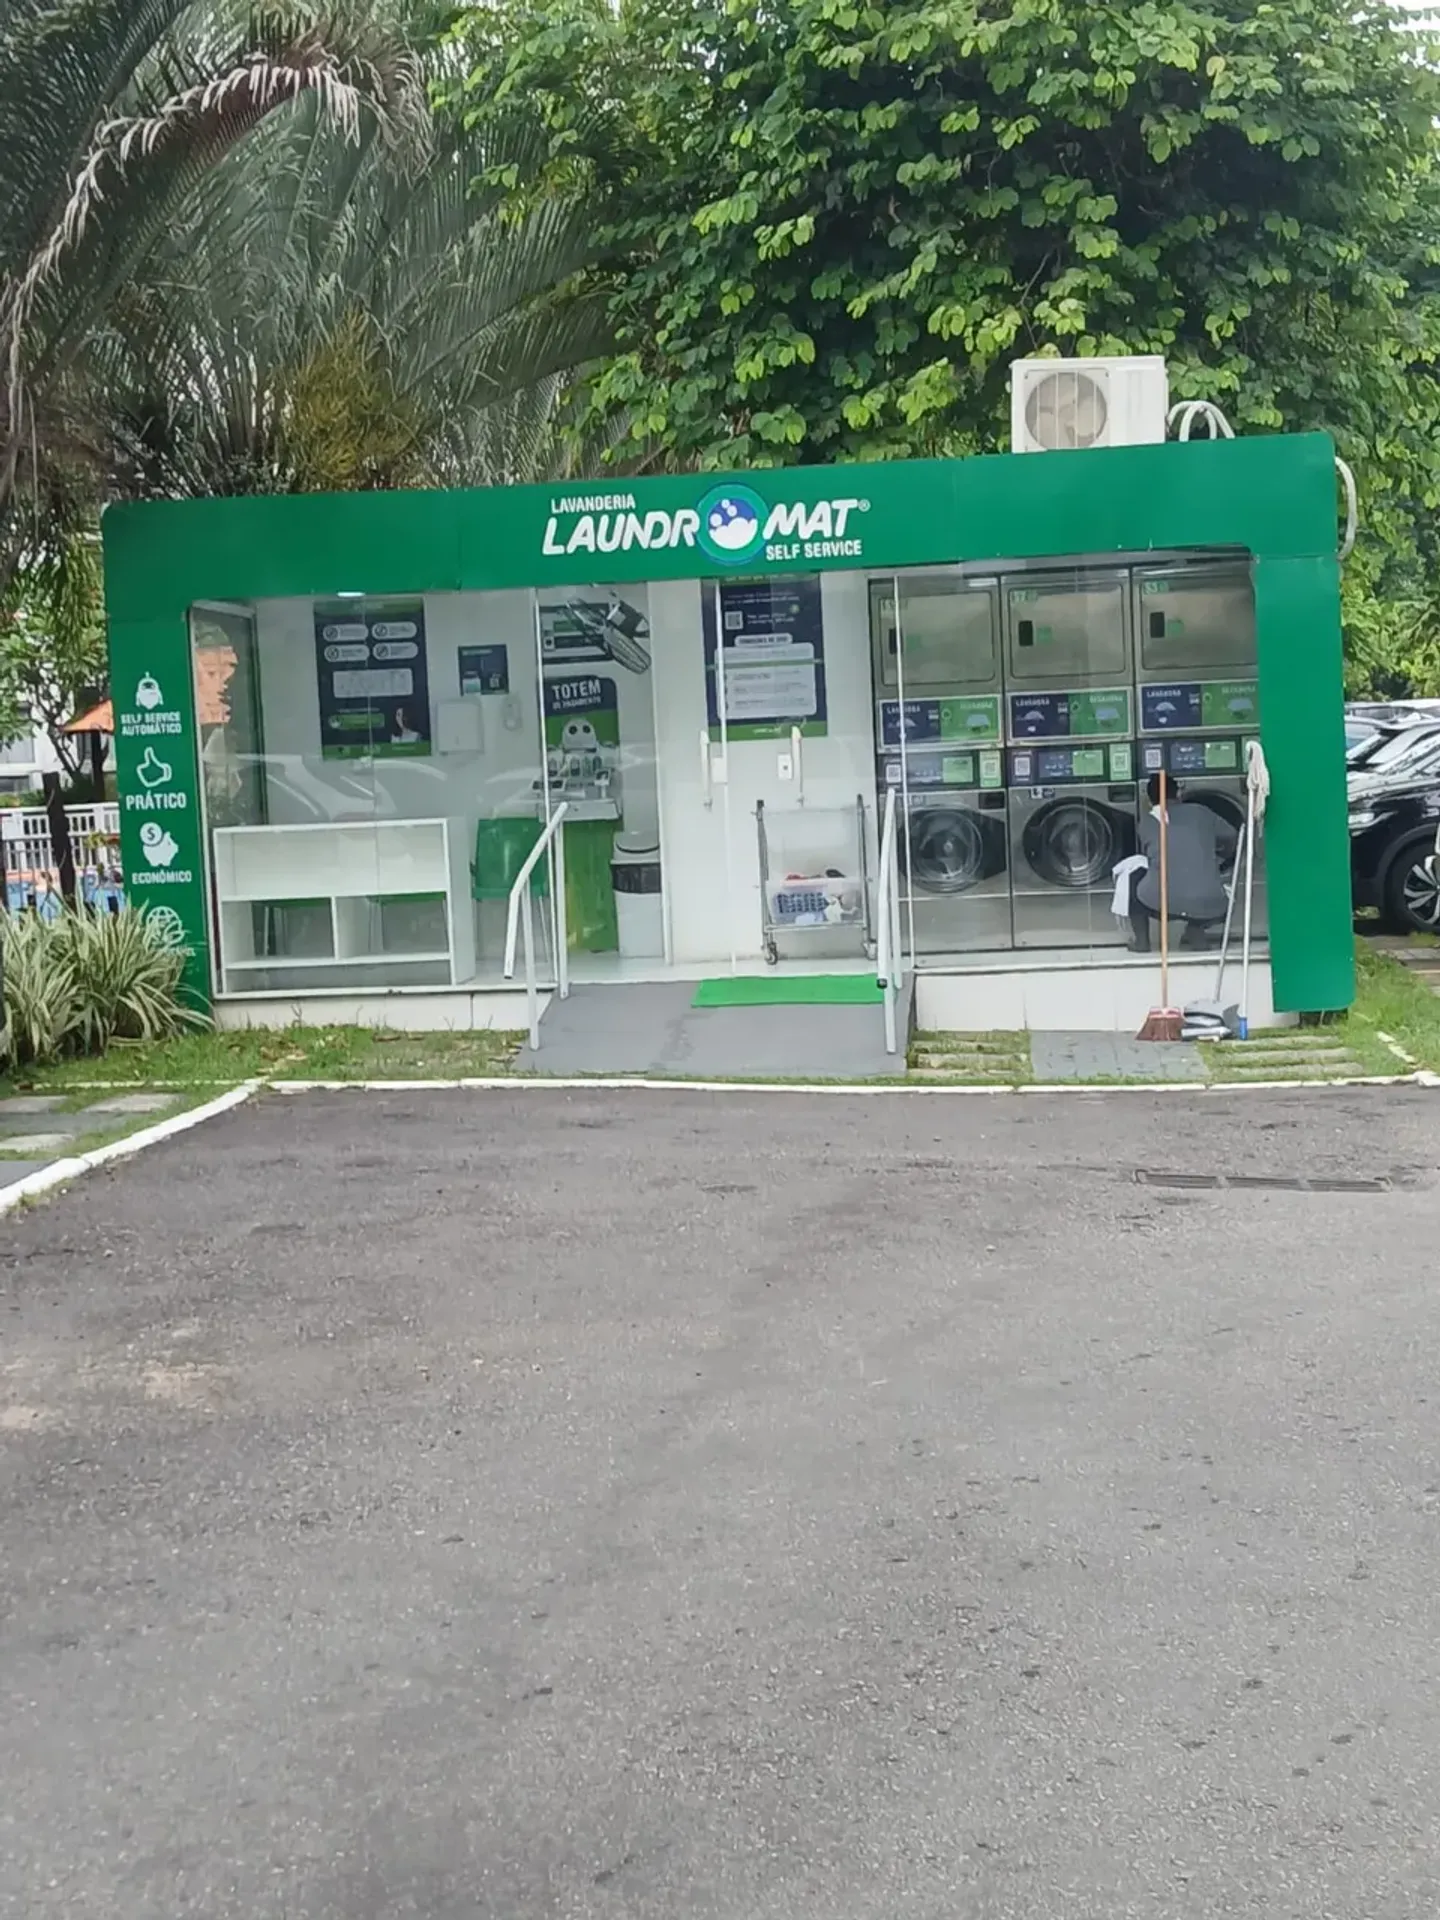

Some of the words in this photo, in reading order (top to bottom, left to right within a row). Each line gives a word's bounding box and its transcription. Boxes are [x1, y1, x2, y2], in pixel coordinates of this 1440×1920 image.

[550, 493, 636, 514] LAVANDERIA
[766, 543, 800, 561] SELF
[804, 539, 862, 558] SERVICE
[551, 679, 601, 700] TOTEM
[121, 722, 182, 736] AUTOMÁTICO
[126, 790, 187, 811] PRÁTICO
